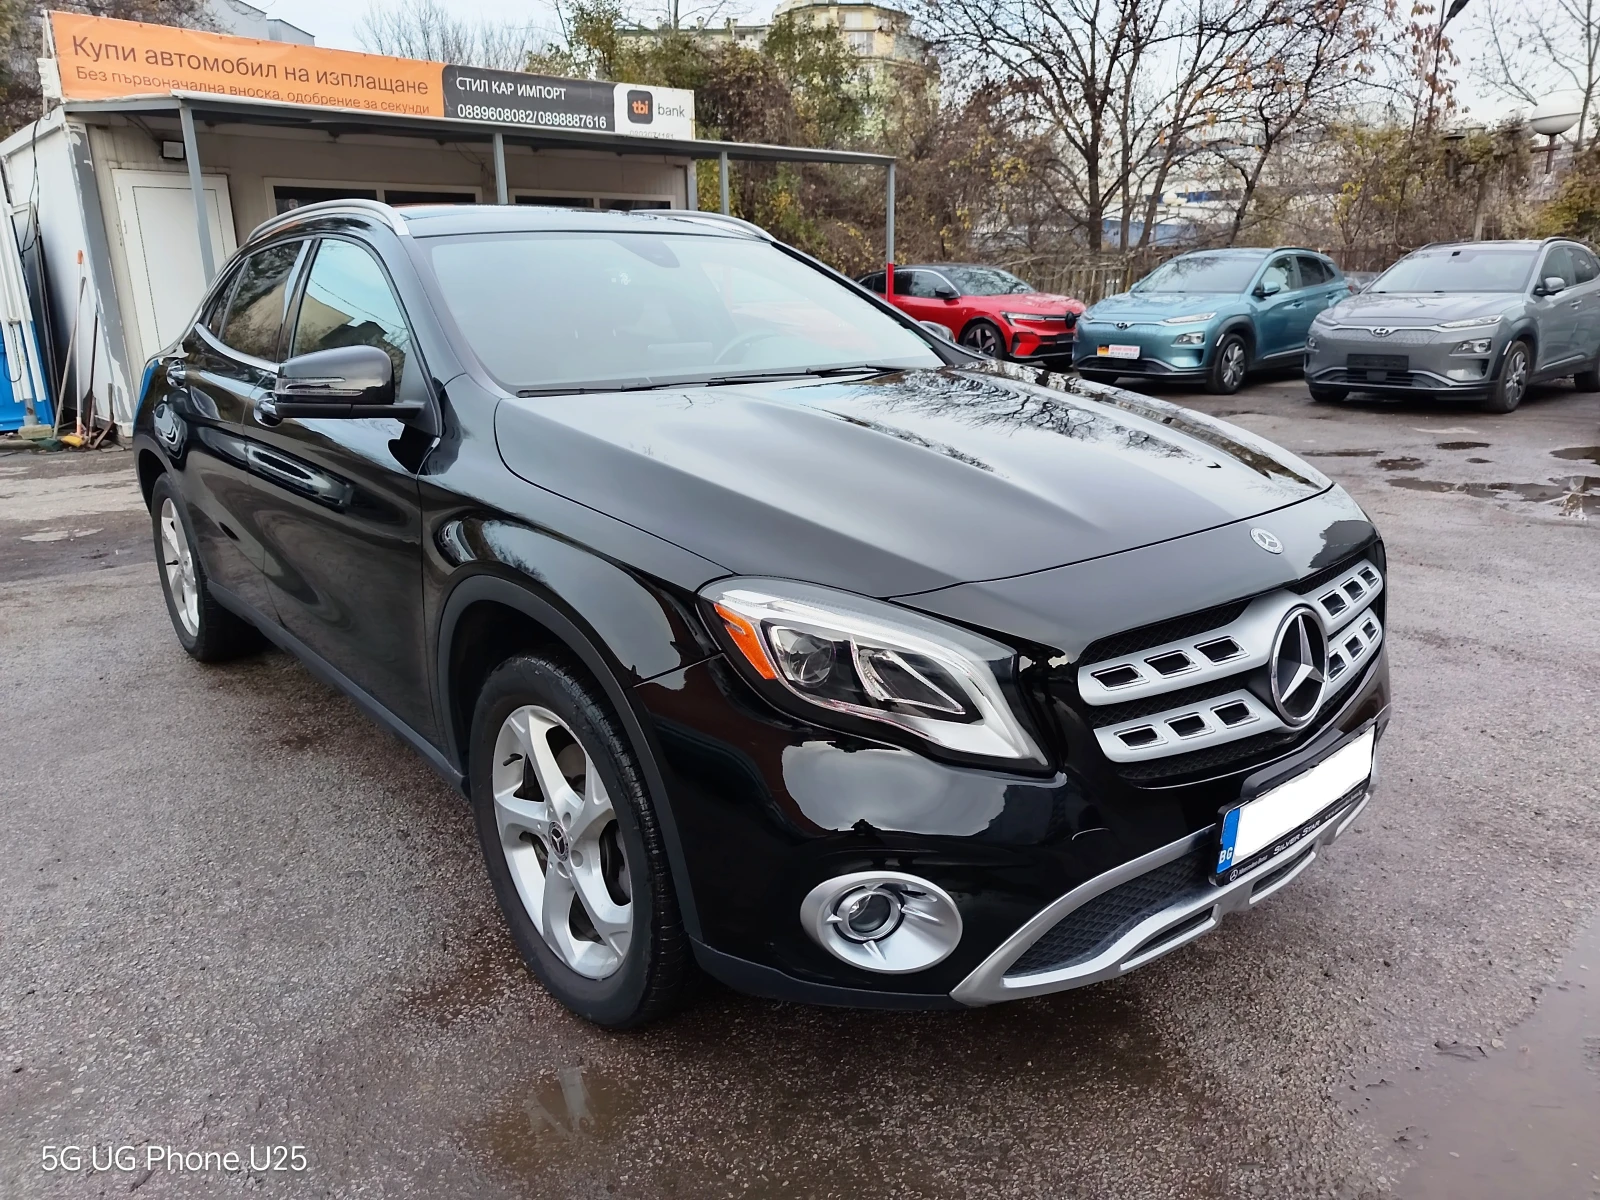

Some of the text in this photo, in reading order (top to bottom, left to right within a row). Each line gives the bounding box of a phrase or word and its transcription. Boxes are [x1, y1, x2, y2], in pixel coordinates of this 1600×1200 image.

[72, 35, 429, 95] Купи автомобил на изплащане
[76, 66, 430, 114] Без първоначална вноска, одобрение за секунди
[456, 77, 567, 101] СТИЛ КАР ИМПОРТ
[457, 103, 607, 129] 0889608082/0898887616
[632, 100, 685, 118] tbi bank
[1218, 846, 1234, 865] BG
